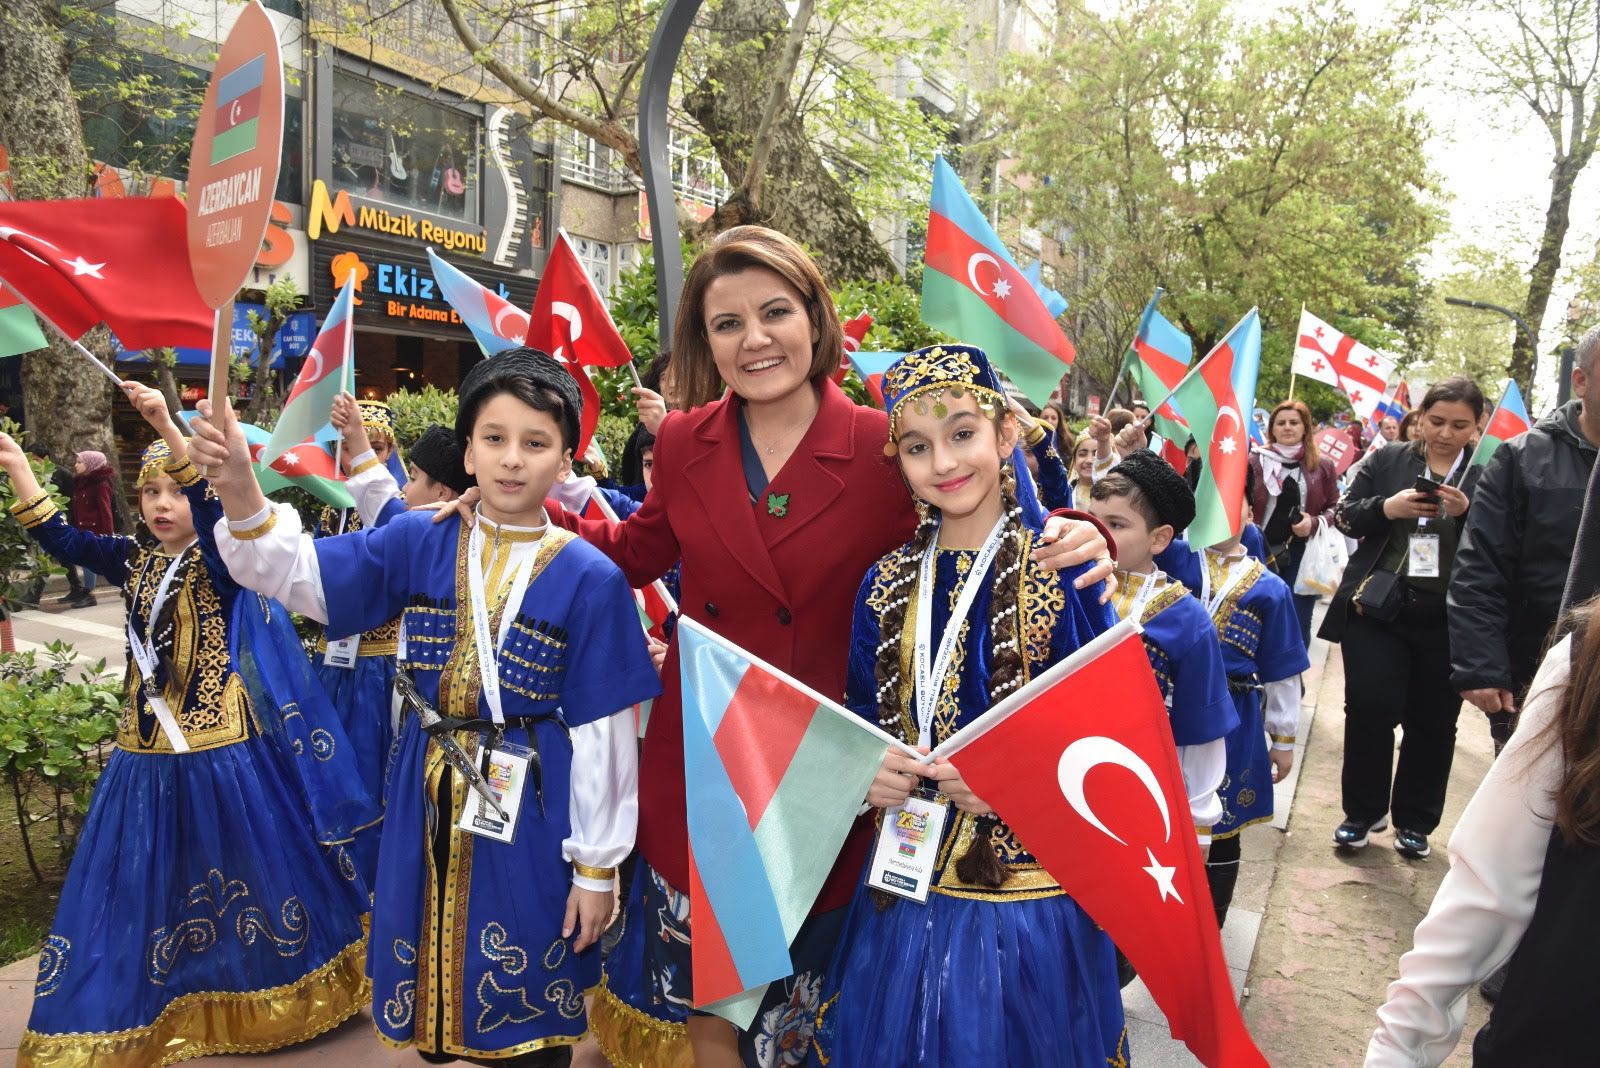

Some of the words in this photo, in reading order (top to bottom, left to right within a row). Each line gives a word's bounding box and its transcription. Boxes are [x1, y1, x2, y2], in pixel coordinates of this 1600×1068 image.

[198, 166, 262, 216] AZERBAYCAN
[359, 205, 418, 238] Müzik
[421, 219, 487, 253] Reyonu
[378, 263, 434, 300] Ekiz
[387, 300, 406, 317] Bir
[409, 303, 448, 323] Adana
